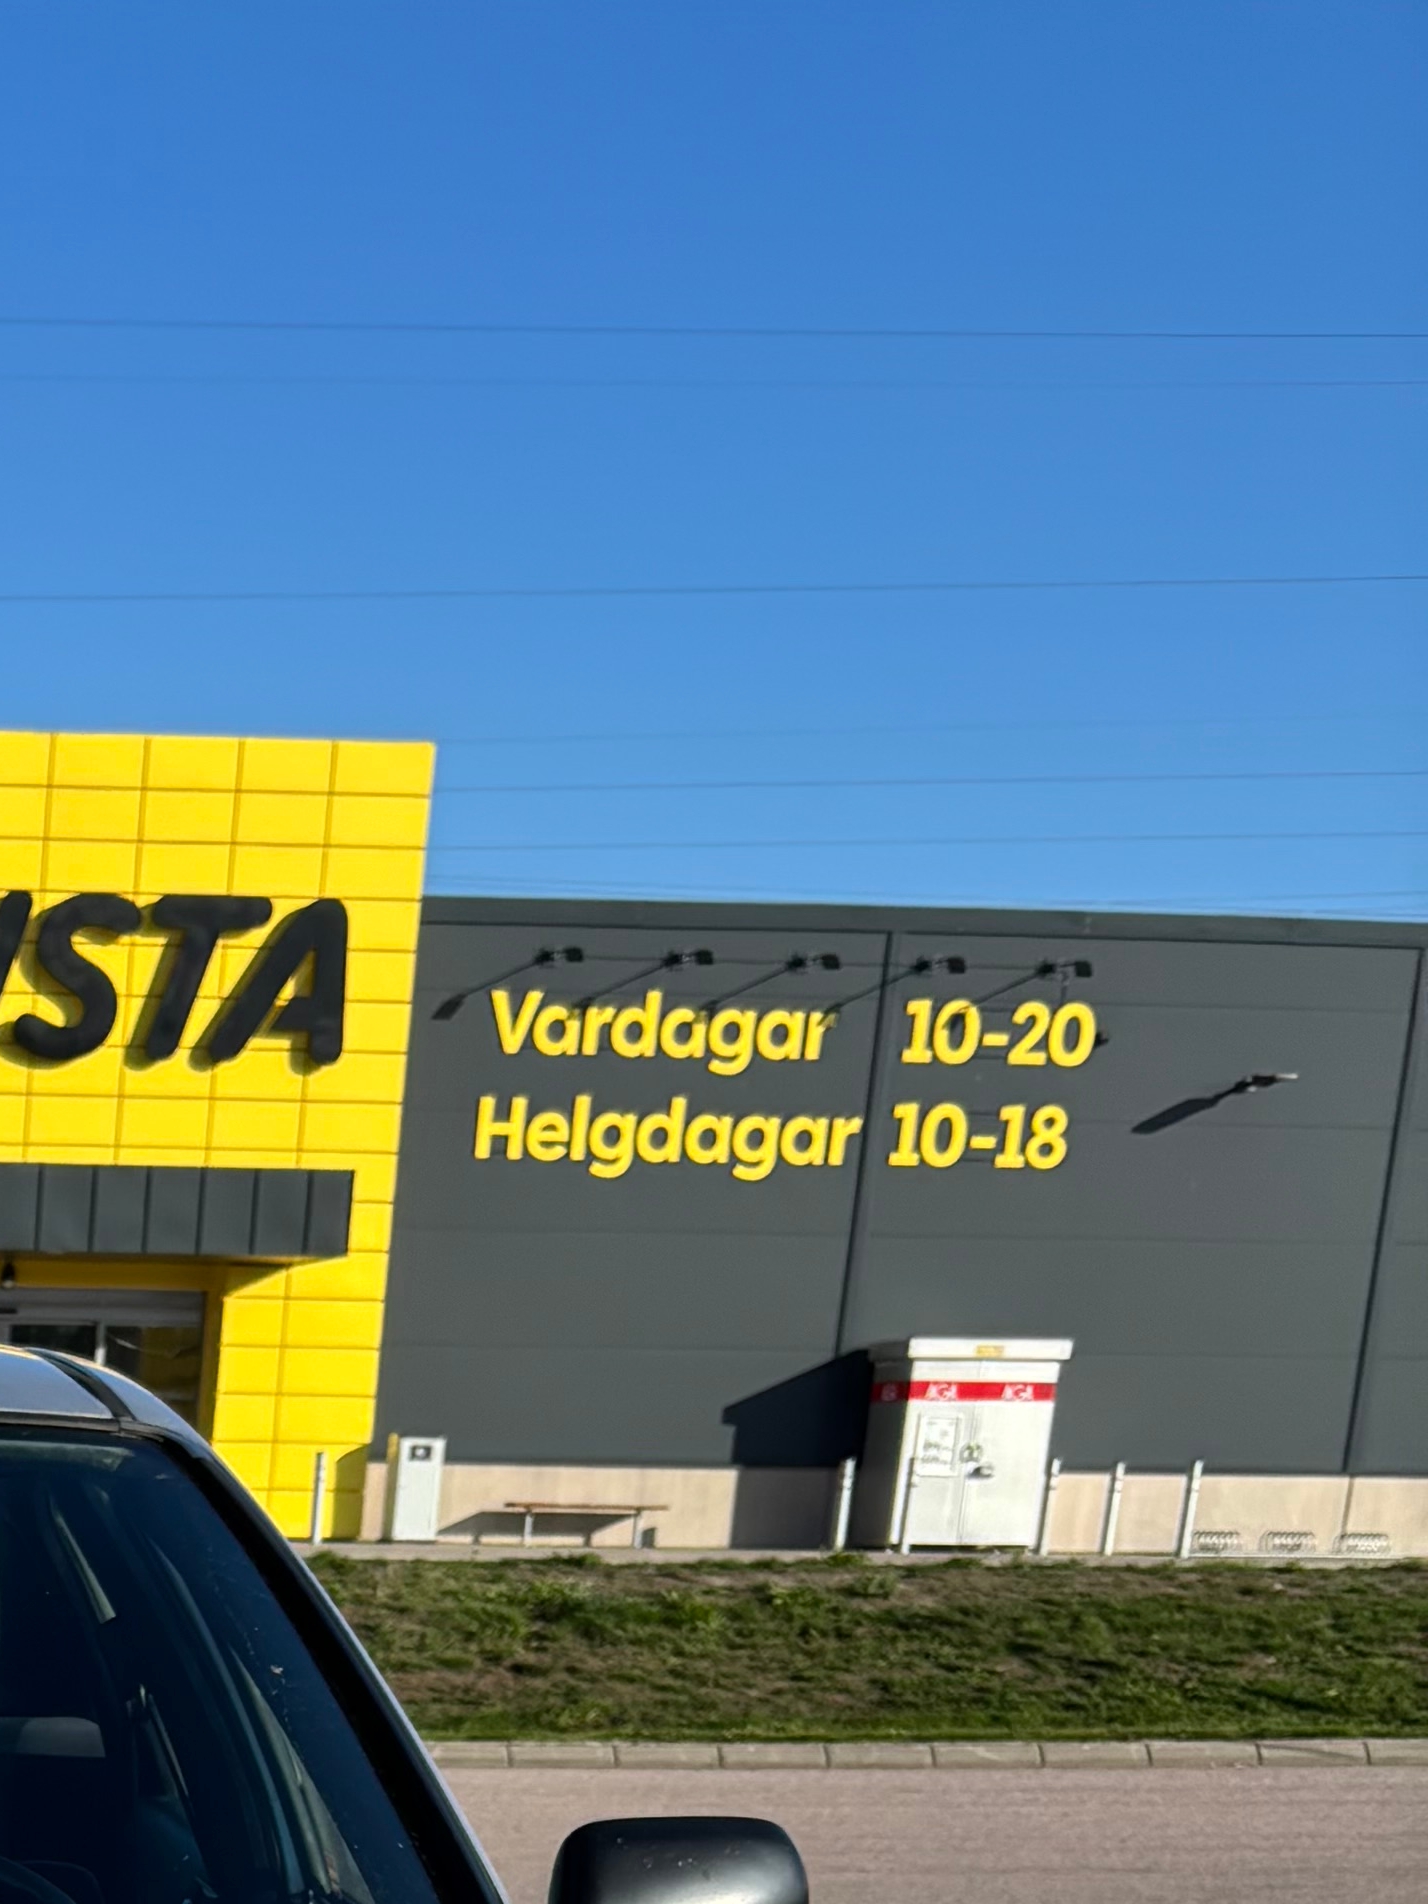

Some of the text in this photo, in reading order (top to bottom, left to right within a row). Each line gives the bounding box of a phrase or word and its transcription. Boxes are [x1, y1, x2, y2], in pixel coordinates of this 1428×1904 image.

[491, 989, 1097, 1076] Vardagar 10-20
[473, 1094, 1068, 1182] Helgdagar 10-18
[924, 1381, 959, 1401] AGA
[1001, 1383, 1035, 1402] AGA
